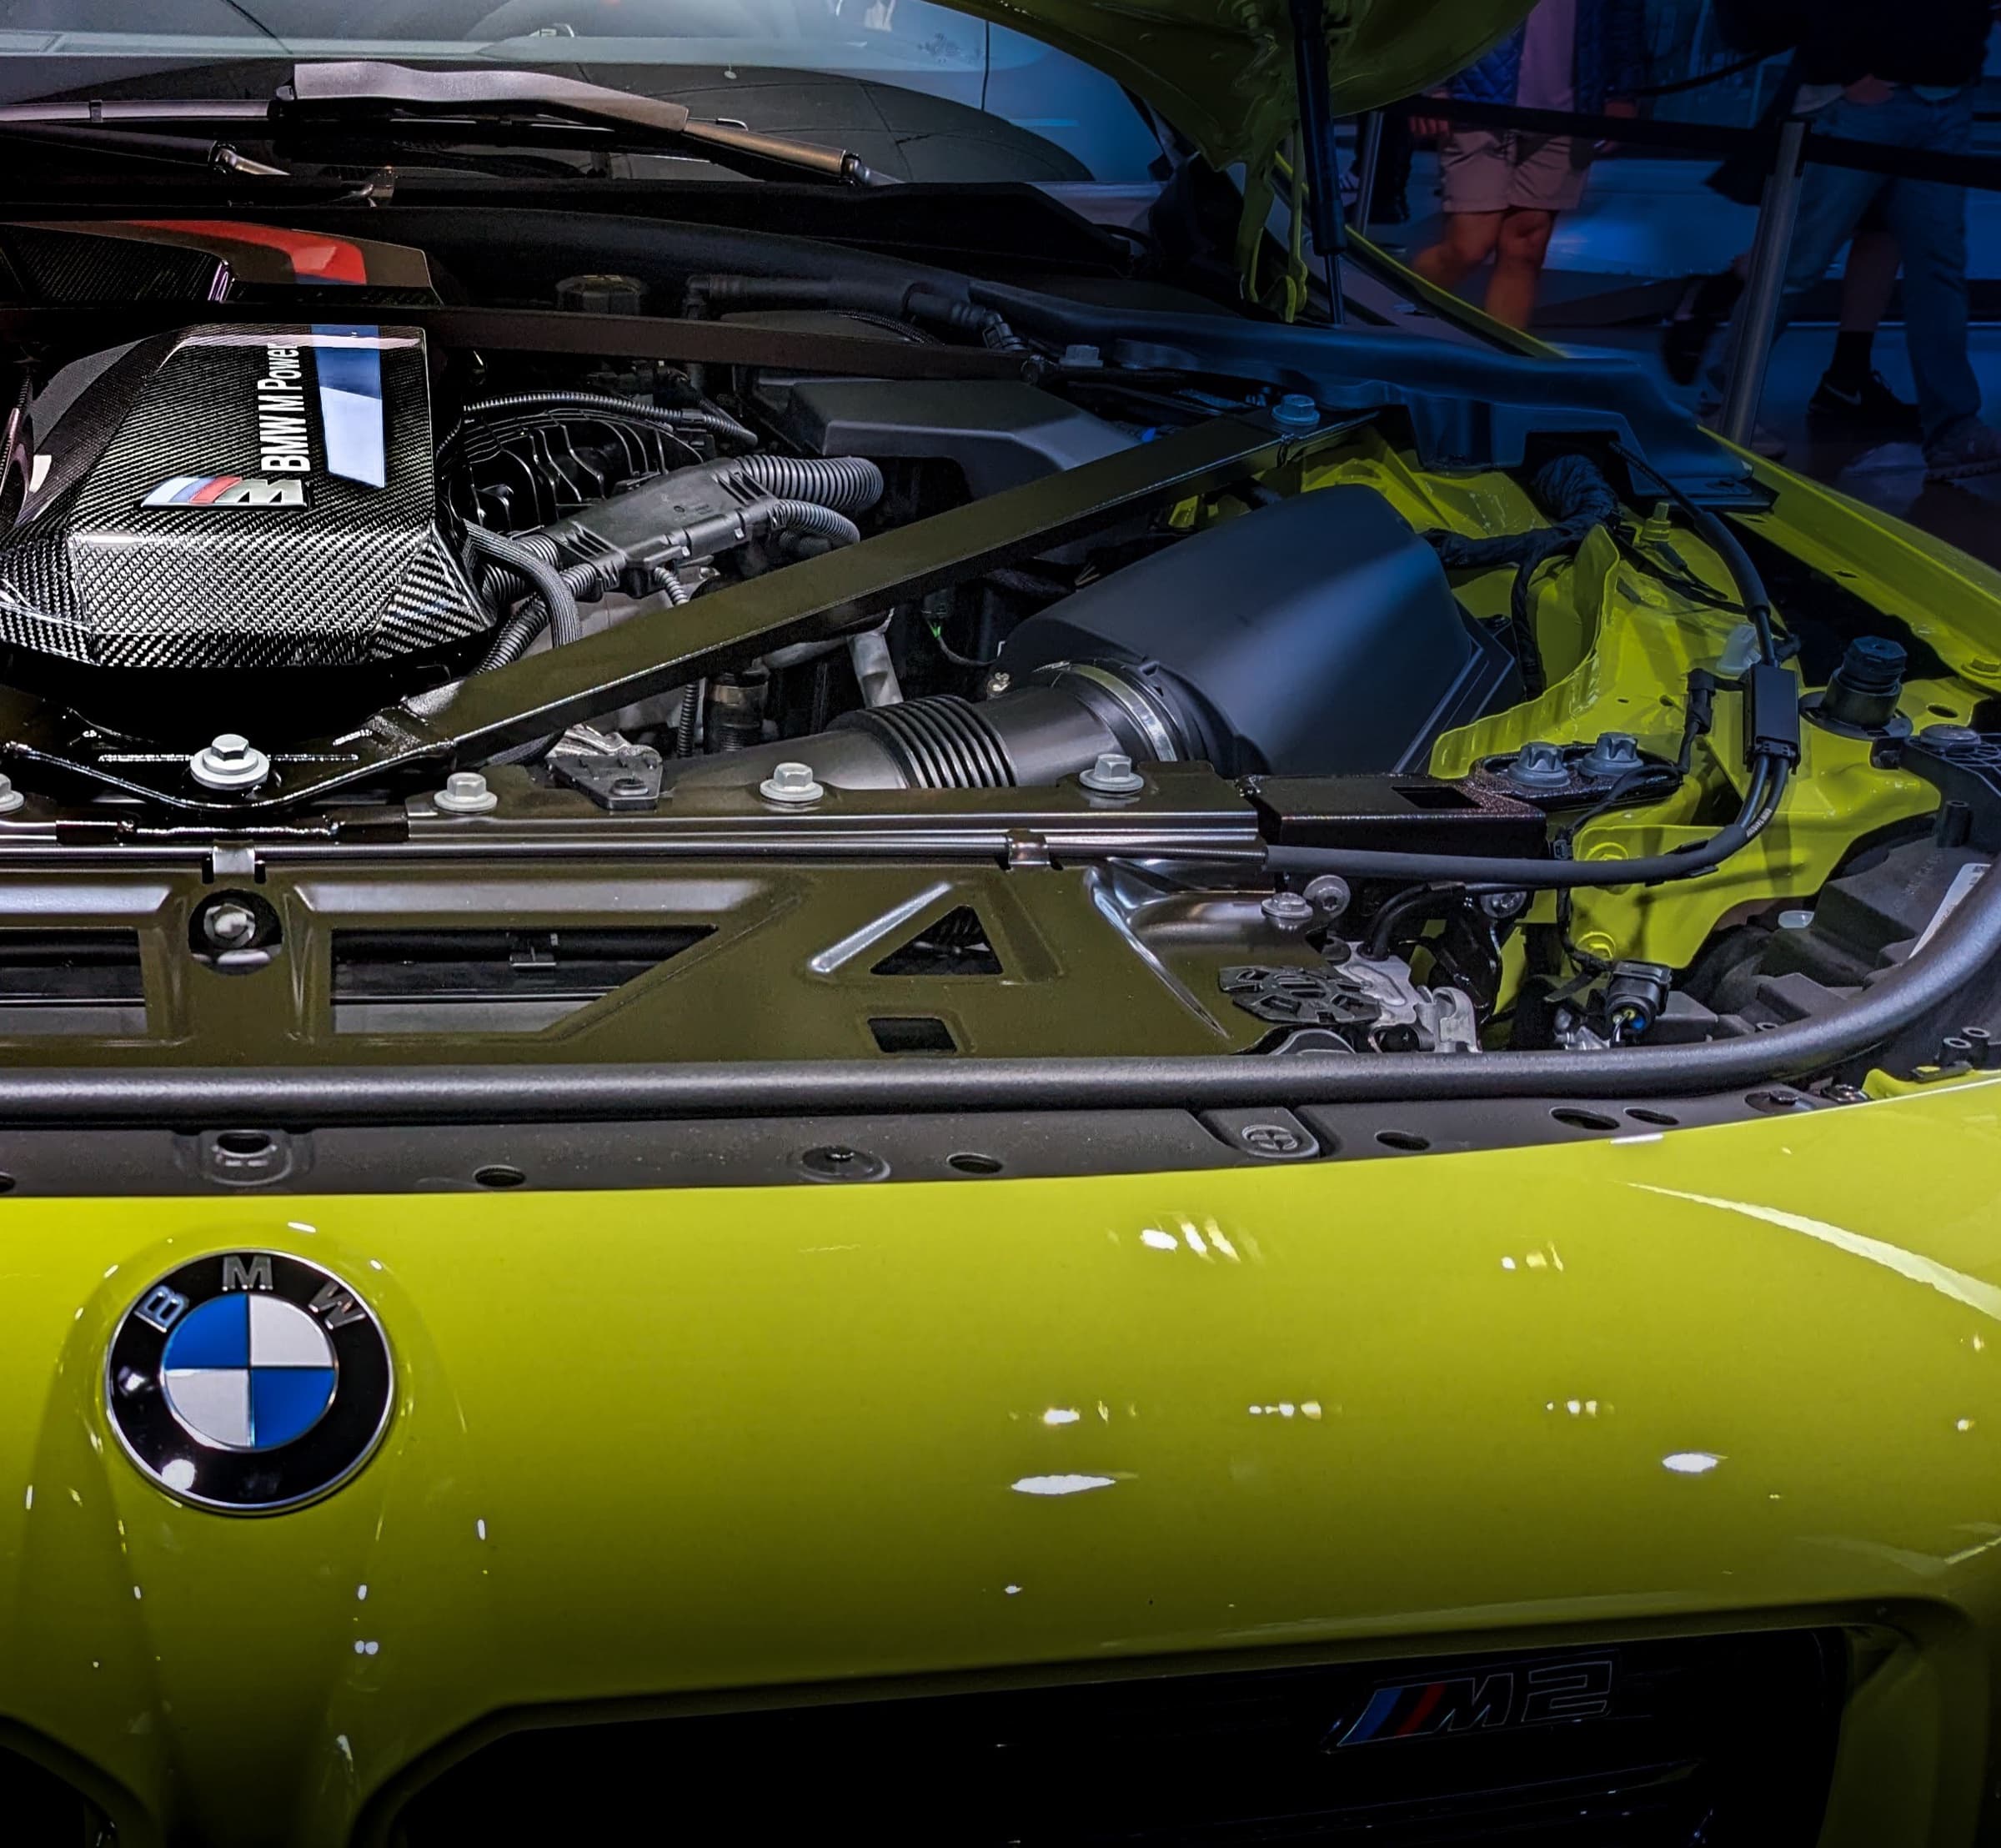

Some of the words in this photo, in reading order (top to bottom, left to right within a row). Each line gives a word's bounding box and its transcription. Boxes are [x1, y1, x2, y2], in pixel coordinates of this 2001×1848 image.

[258, 343, 303, 390] Power
[258, 395, 305, 411] M
[258, 413, 311, 472] BMW
[133, 1254, 367, 1333] BMW
[1411, 1660, 1612, 1735] M2
